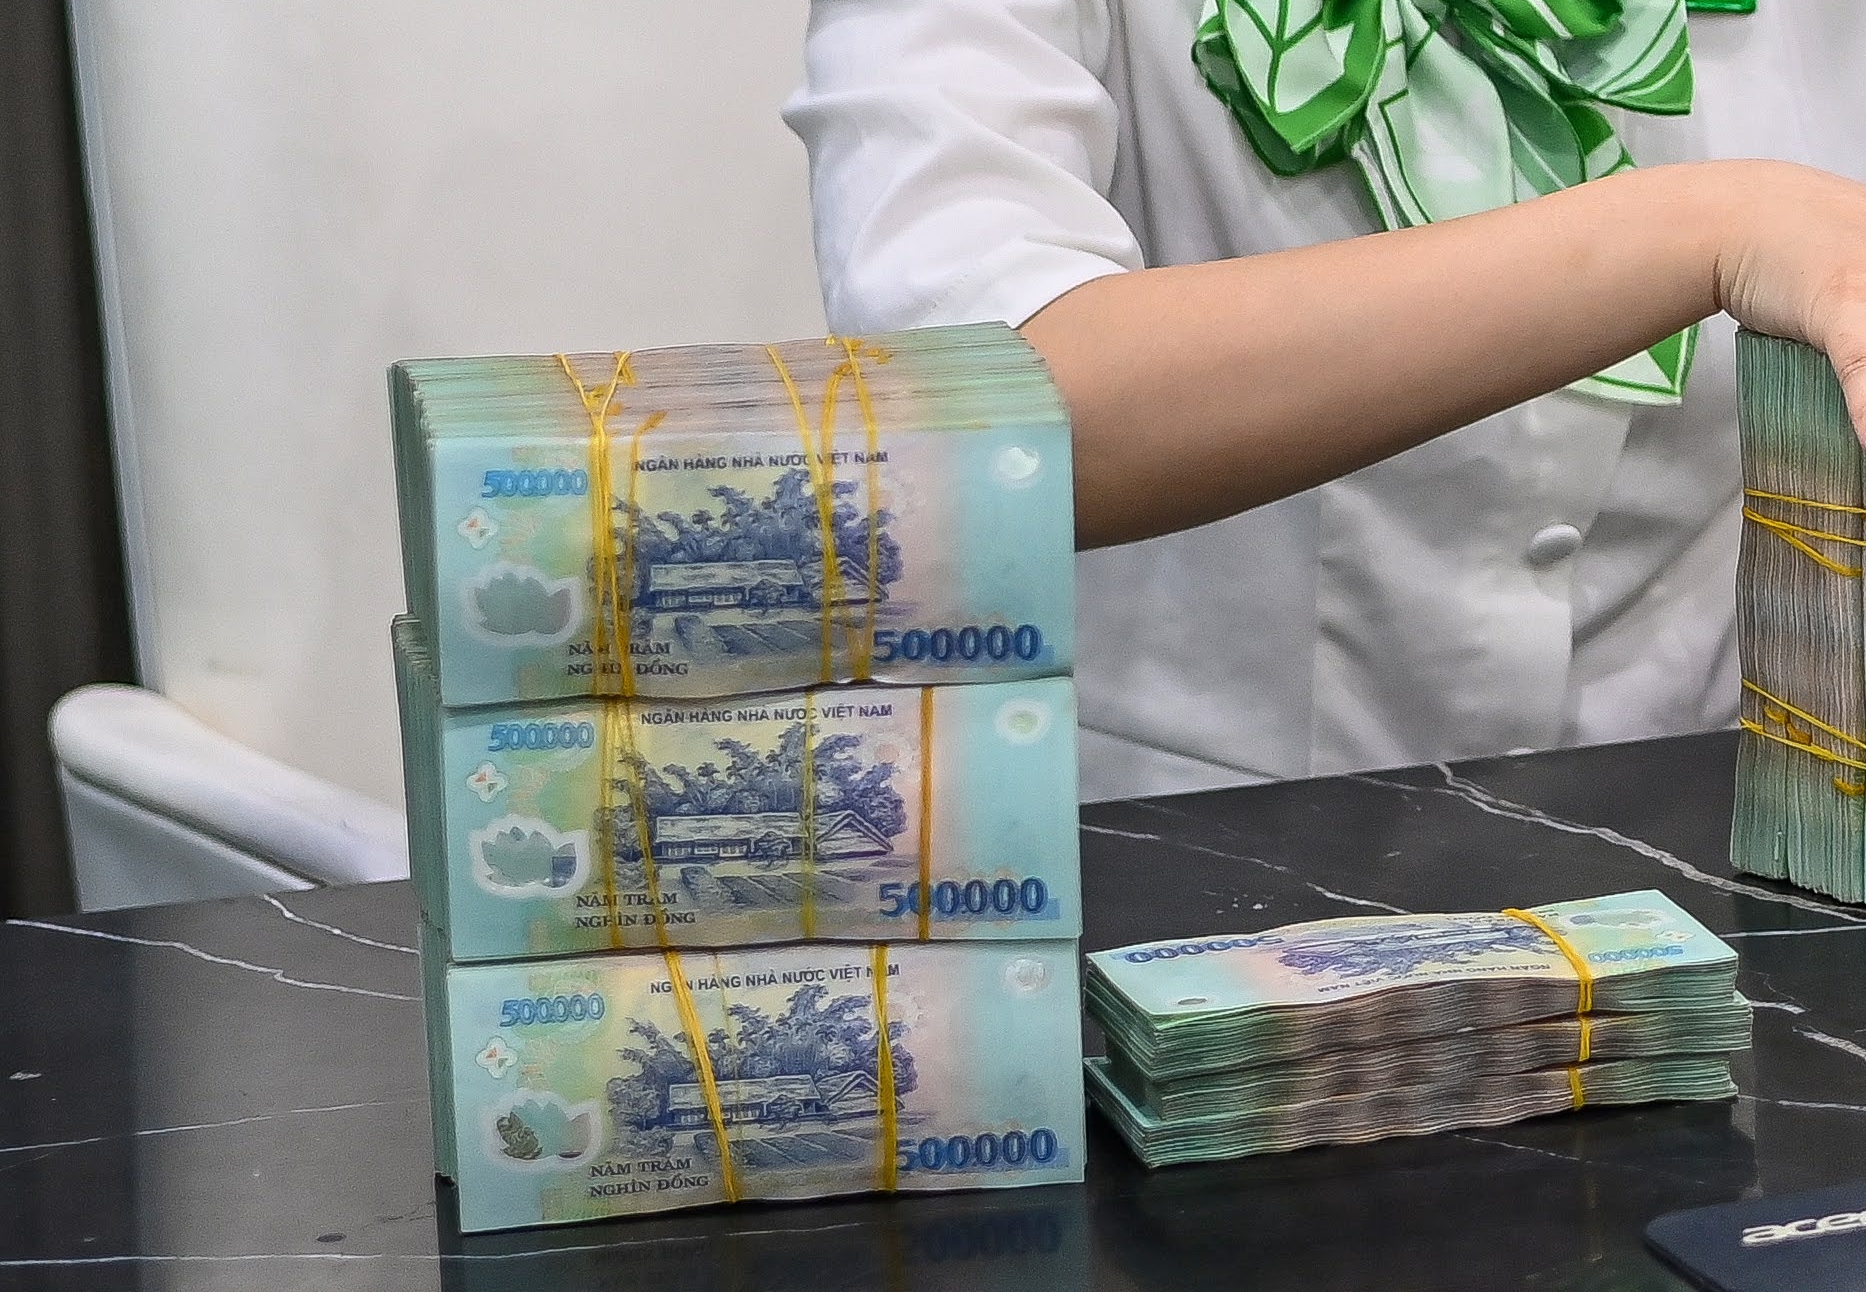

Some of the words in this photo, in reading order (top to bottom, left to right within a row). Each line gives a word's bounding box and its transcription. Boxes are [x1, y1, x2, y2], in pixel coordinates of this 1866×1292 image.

[684, 453, 728, 470] HÀNG
[732, 452, 763, 468] NHÀ
[481, 468, 589, 498] 500000
[873, 623, 1043, 662] 500000
[689, 706, 733, 724] HÀNG
[737, 705, 770, 722] NHÀ
[859, 703, 893, 717] NAM
[487, 721, 595, 752] 500000
[879, 877, 1048, 917] 500000
[1125, 934, 1285, 964] 500000
[650, 979, 694, 994] NGN
[698, 972, 742, 991] HÀNG
[746, 968, 778, 987] NHÀ
[782, 966, 826, 984] NƯỚC
[829, 963, 862, 983] VIỆT
[499, 993, 605, 1027] 500000
[896, 1127, 1058, 1172] 500000
